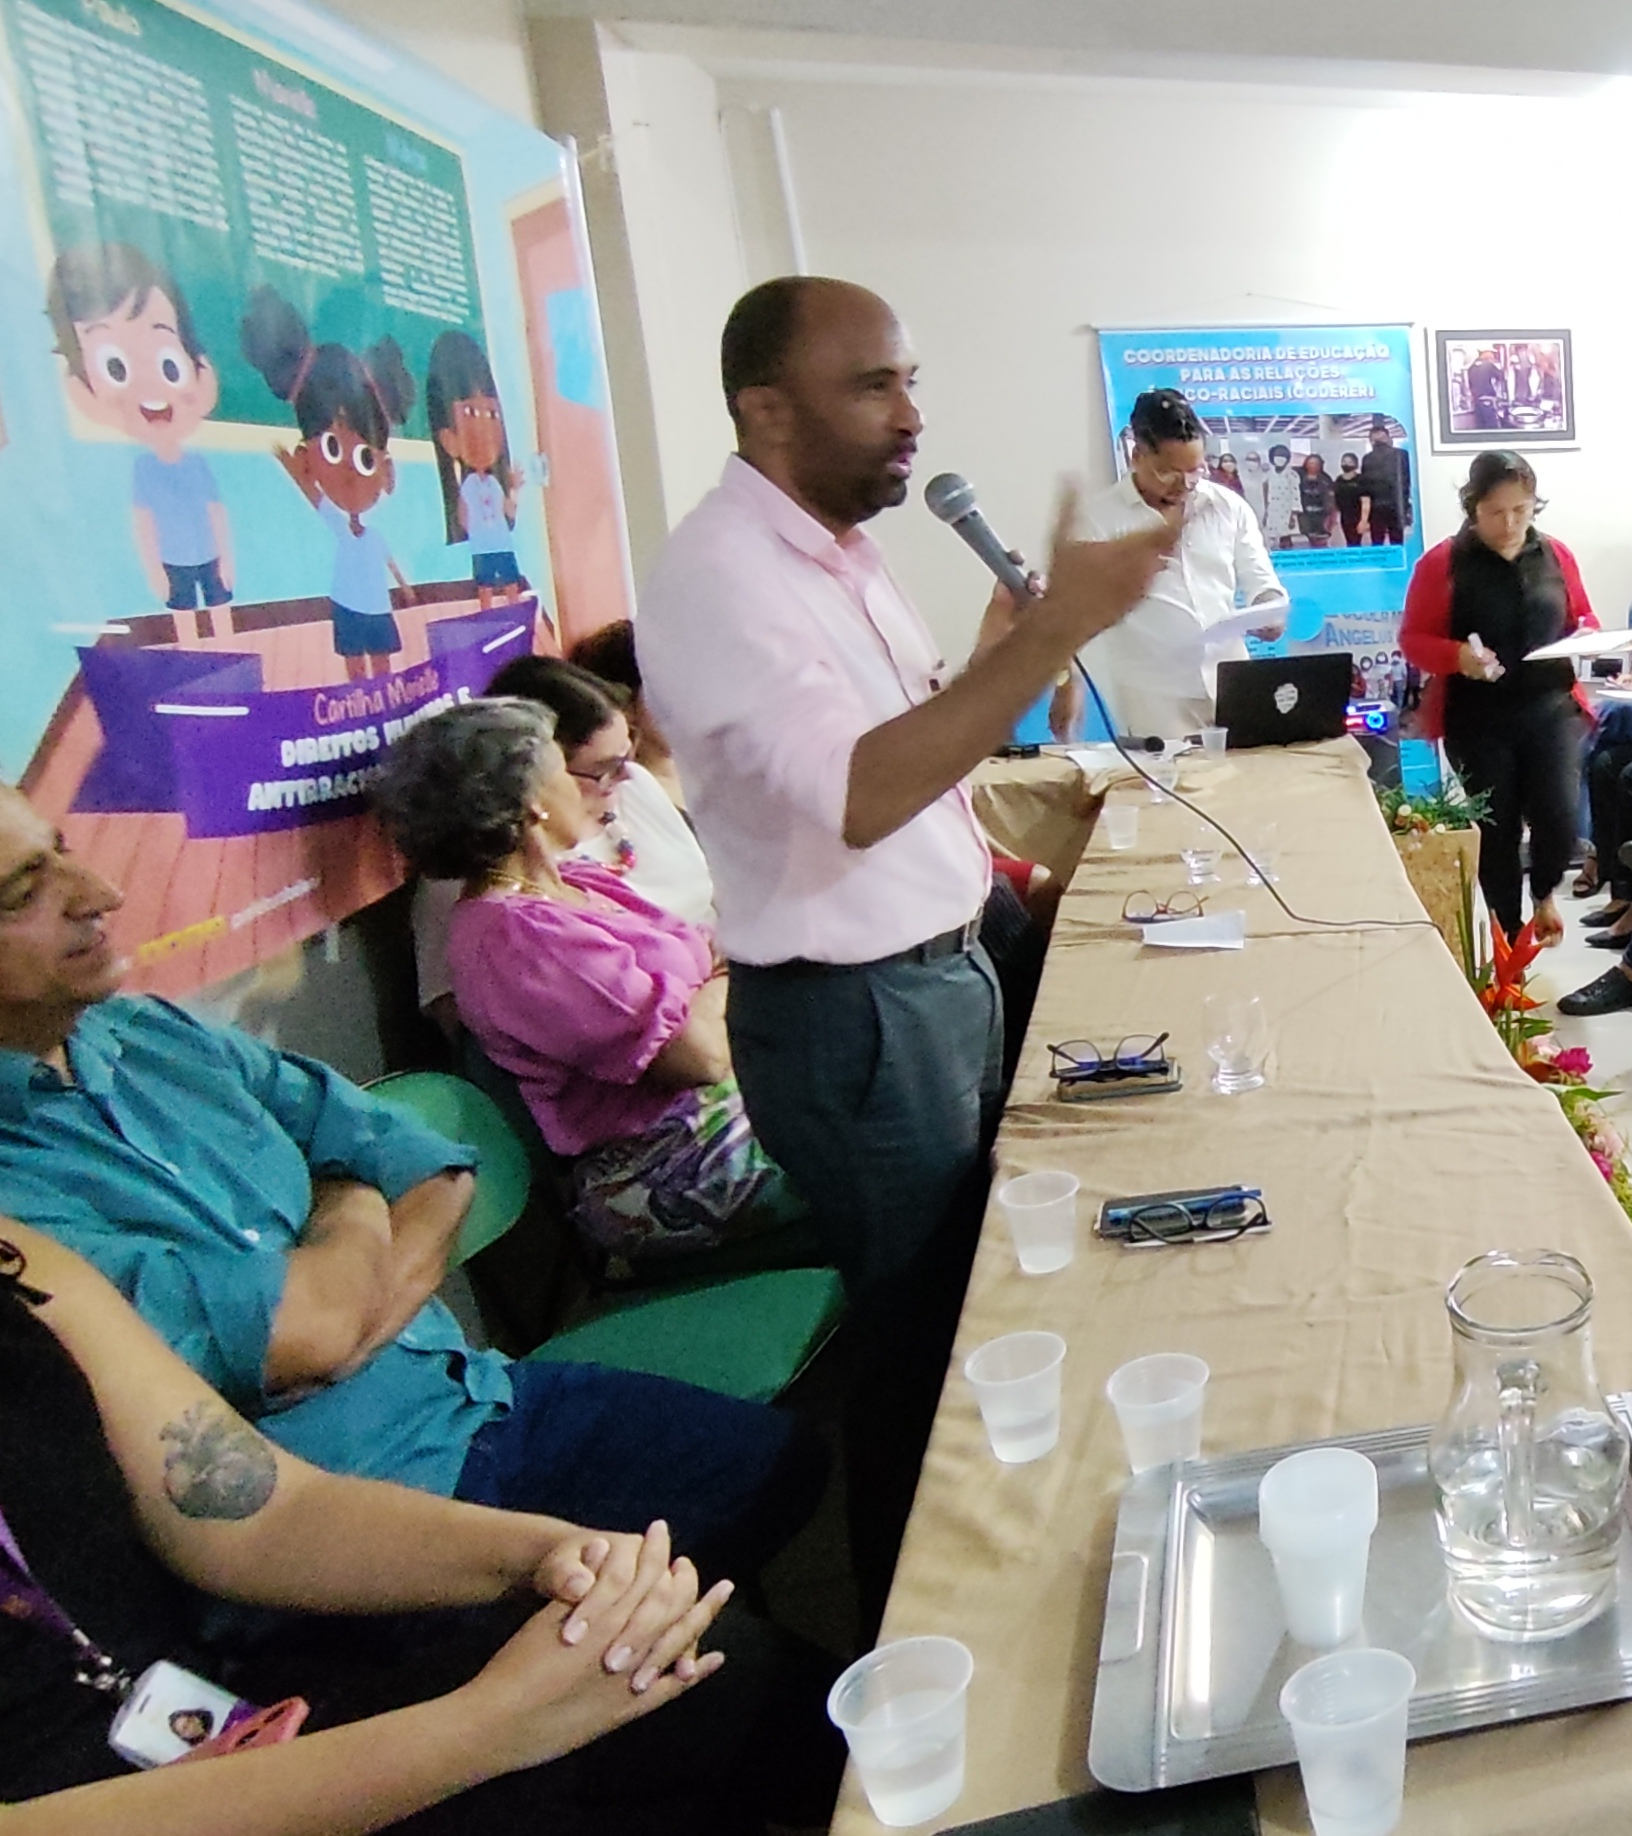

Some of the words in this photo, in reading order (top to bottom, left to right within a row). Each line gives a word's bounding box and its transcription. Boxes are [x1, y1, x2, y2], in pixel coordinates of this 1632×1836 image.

[1124, 346, 1272, 363] COORDENADORIA
[1275, 346, 1297, 360] DE
[1300, 343, 1391, 361] EDUCAÇÃO
[1180, 366, 1226, 382] PARA
[1229, 366, 1251, 381] AS
[1254, 361, 1340, 381] RELAÇÕES
[281, 726, 380, 767] DIREITOS
